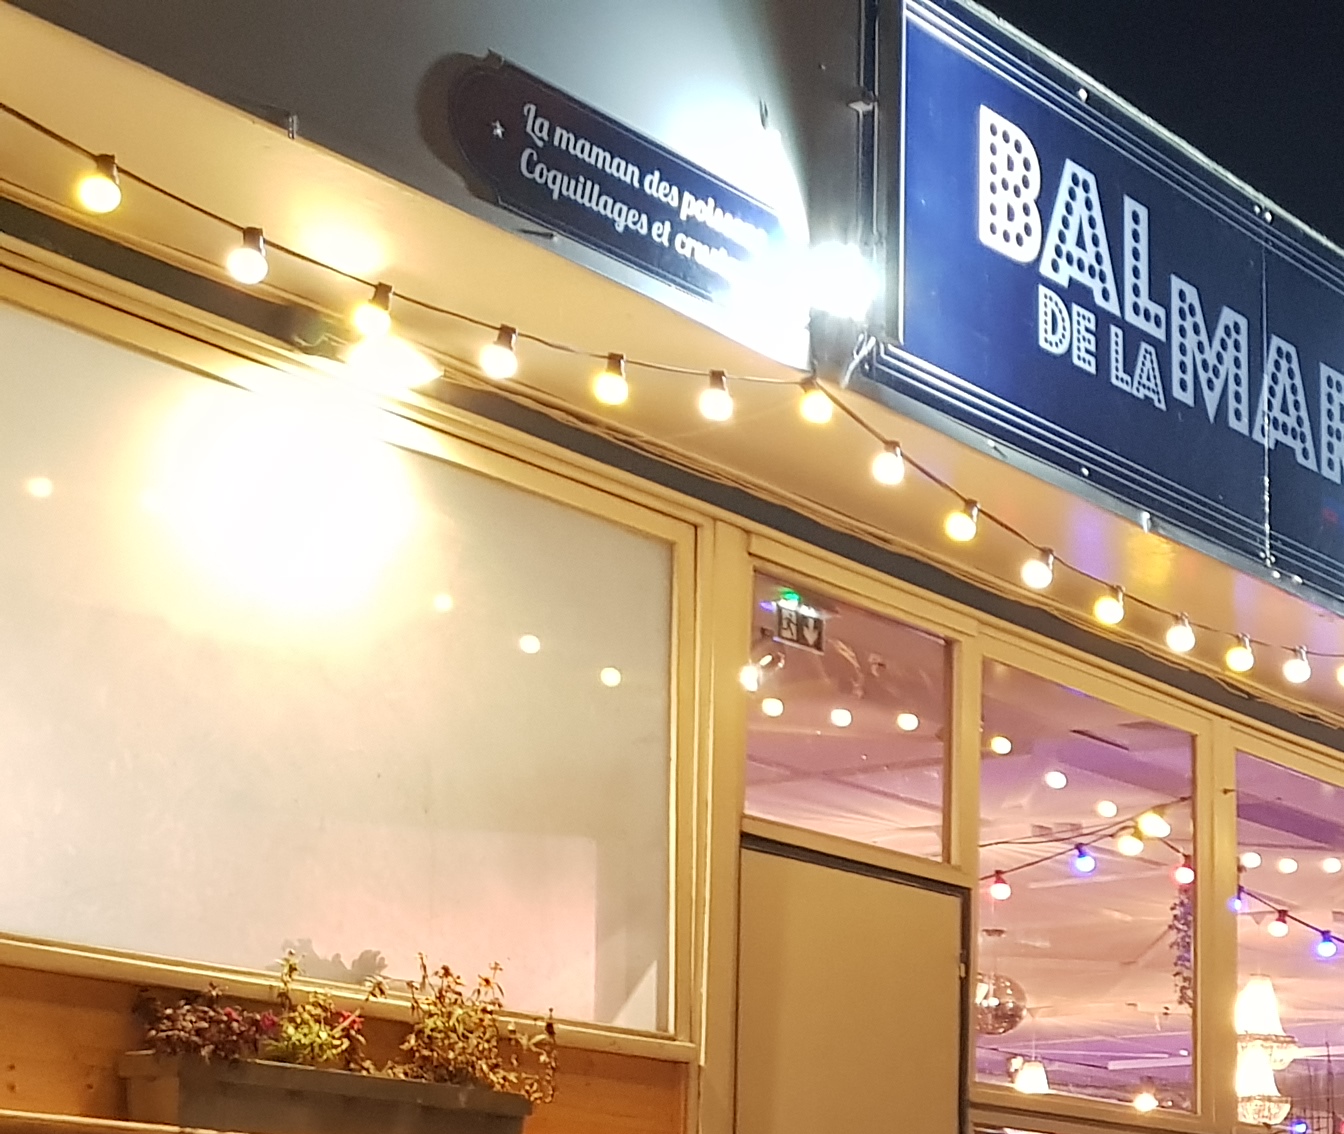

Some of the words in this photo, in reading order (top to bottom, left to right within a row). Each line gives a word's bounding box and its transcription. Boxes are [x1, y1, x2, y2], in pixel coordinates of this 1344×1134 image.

[520, 148, 648, 235] Coquillages
[651, 220, 671, 248] et
[523, 103, 550, 147] La
[553, 126, 640, 189] maman
[643, 170, 680, 207] des
[979, 104, 1166, 343] BAL
[1038, 283, 1097, 376] DE
[1110, 324, 1167, 412] LA
